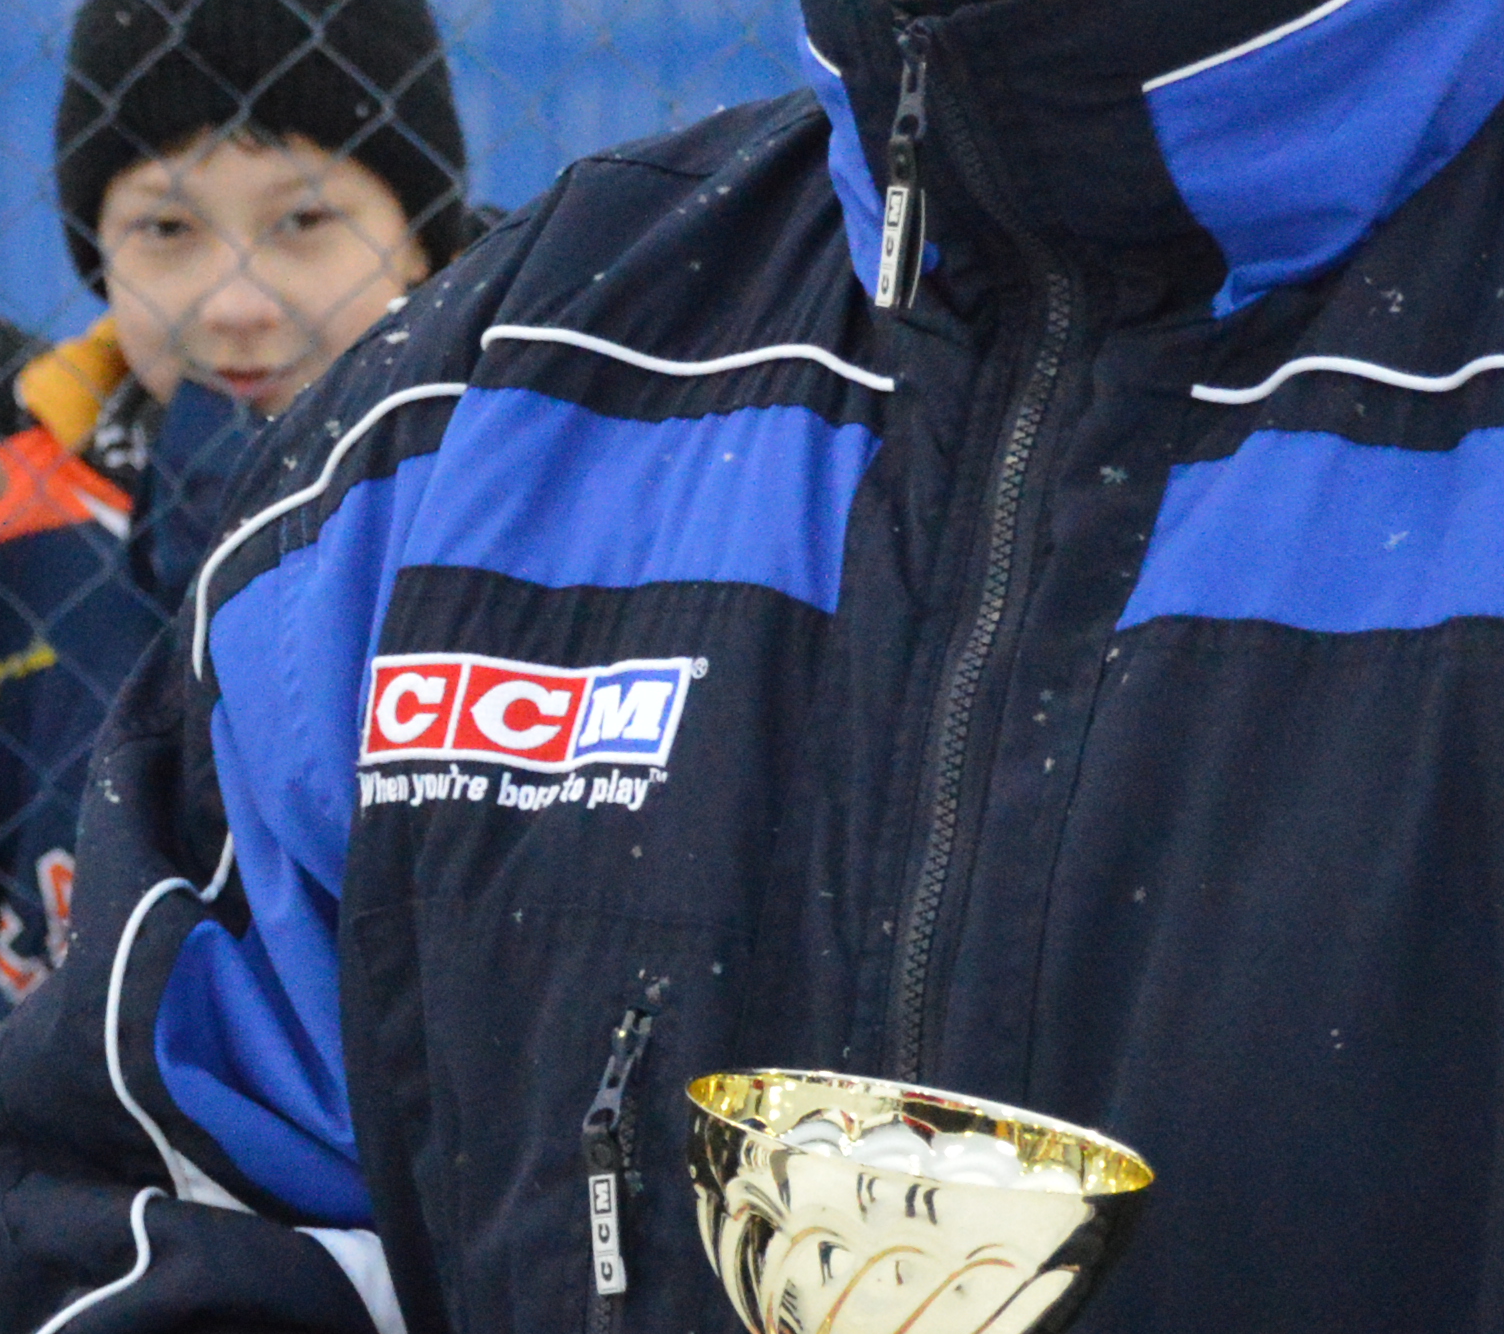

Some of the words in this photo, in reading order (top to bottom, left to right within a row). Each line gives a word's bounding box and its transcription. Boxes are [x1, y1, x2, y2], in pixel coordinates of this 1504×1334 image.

[376, 672, 673, 749] CCM
[559, 772, 586, 803] to
[594, 1179, 613, 1282] CCM
